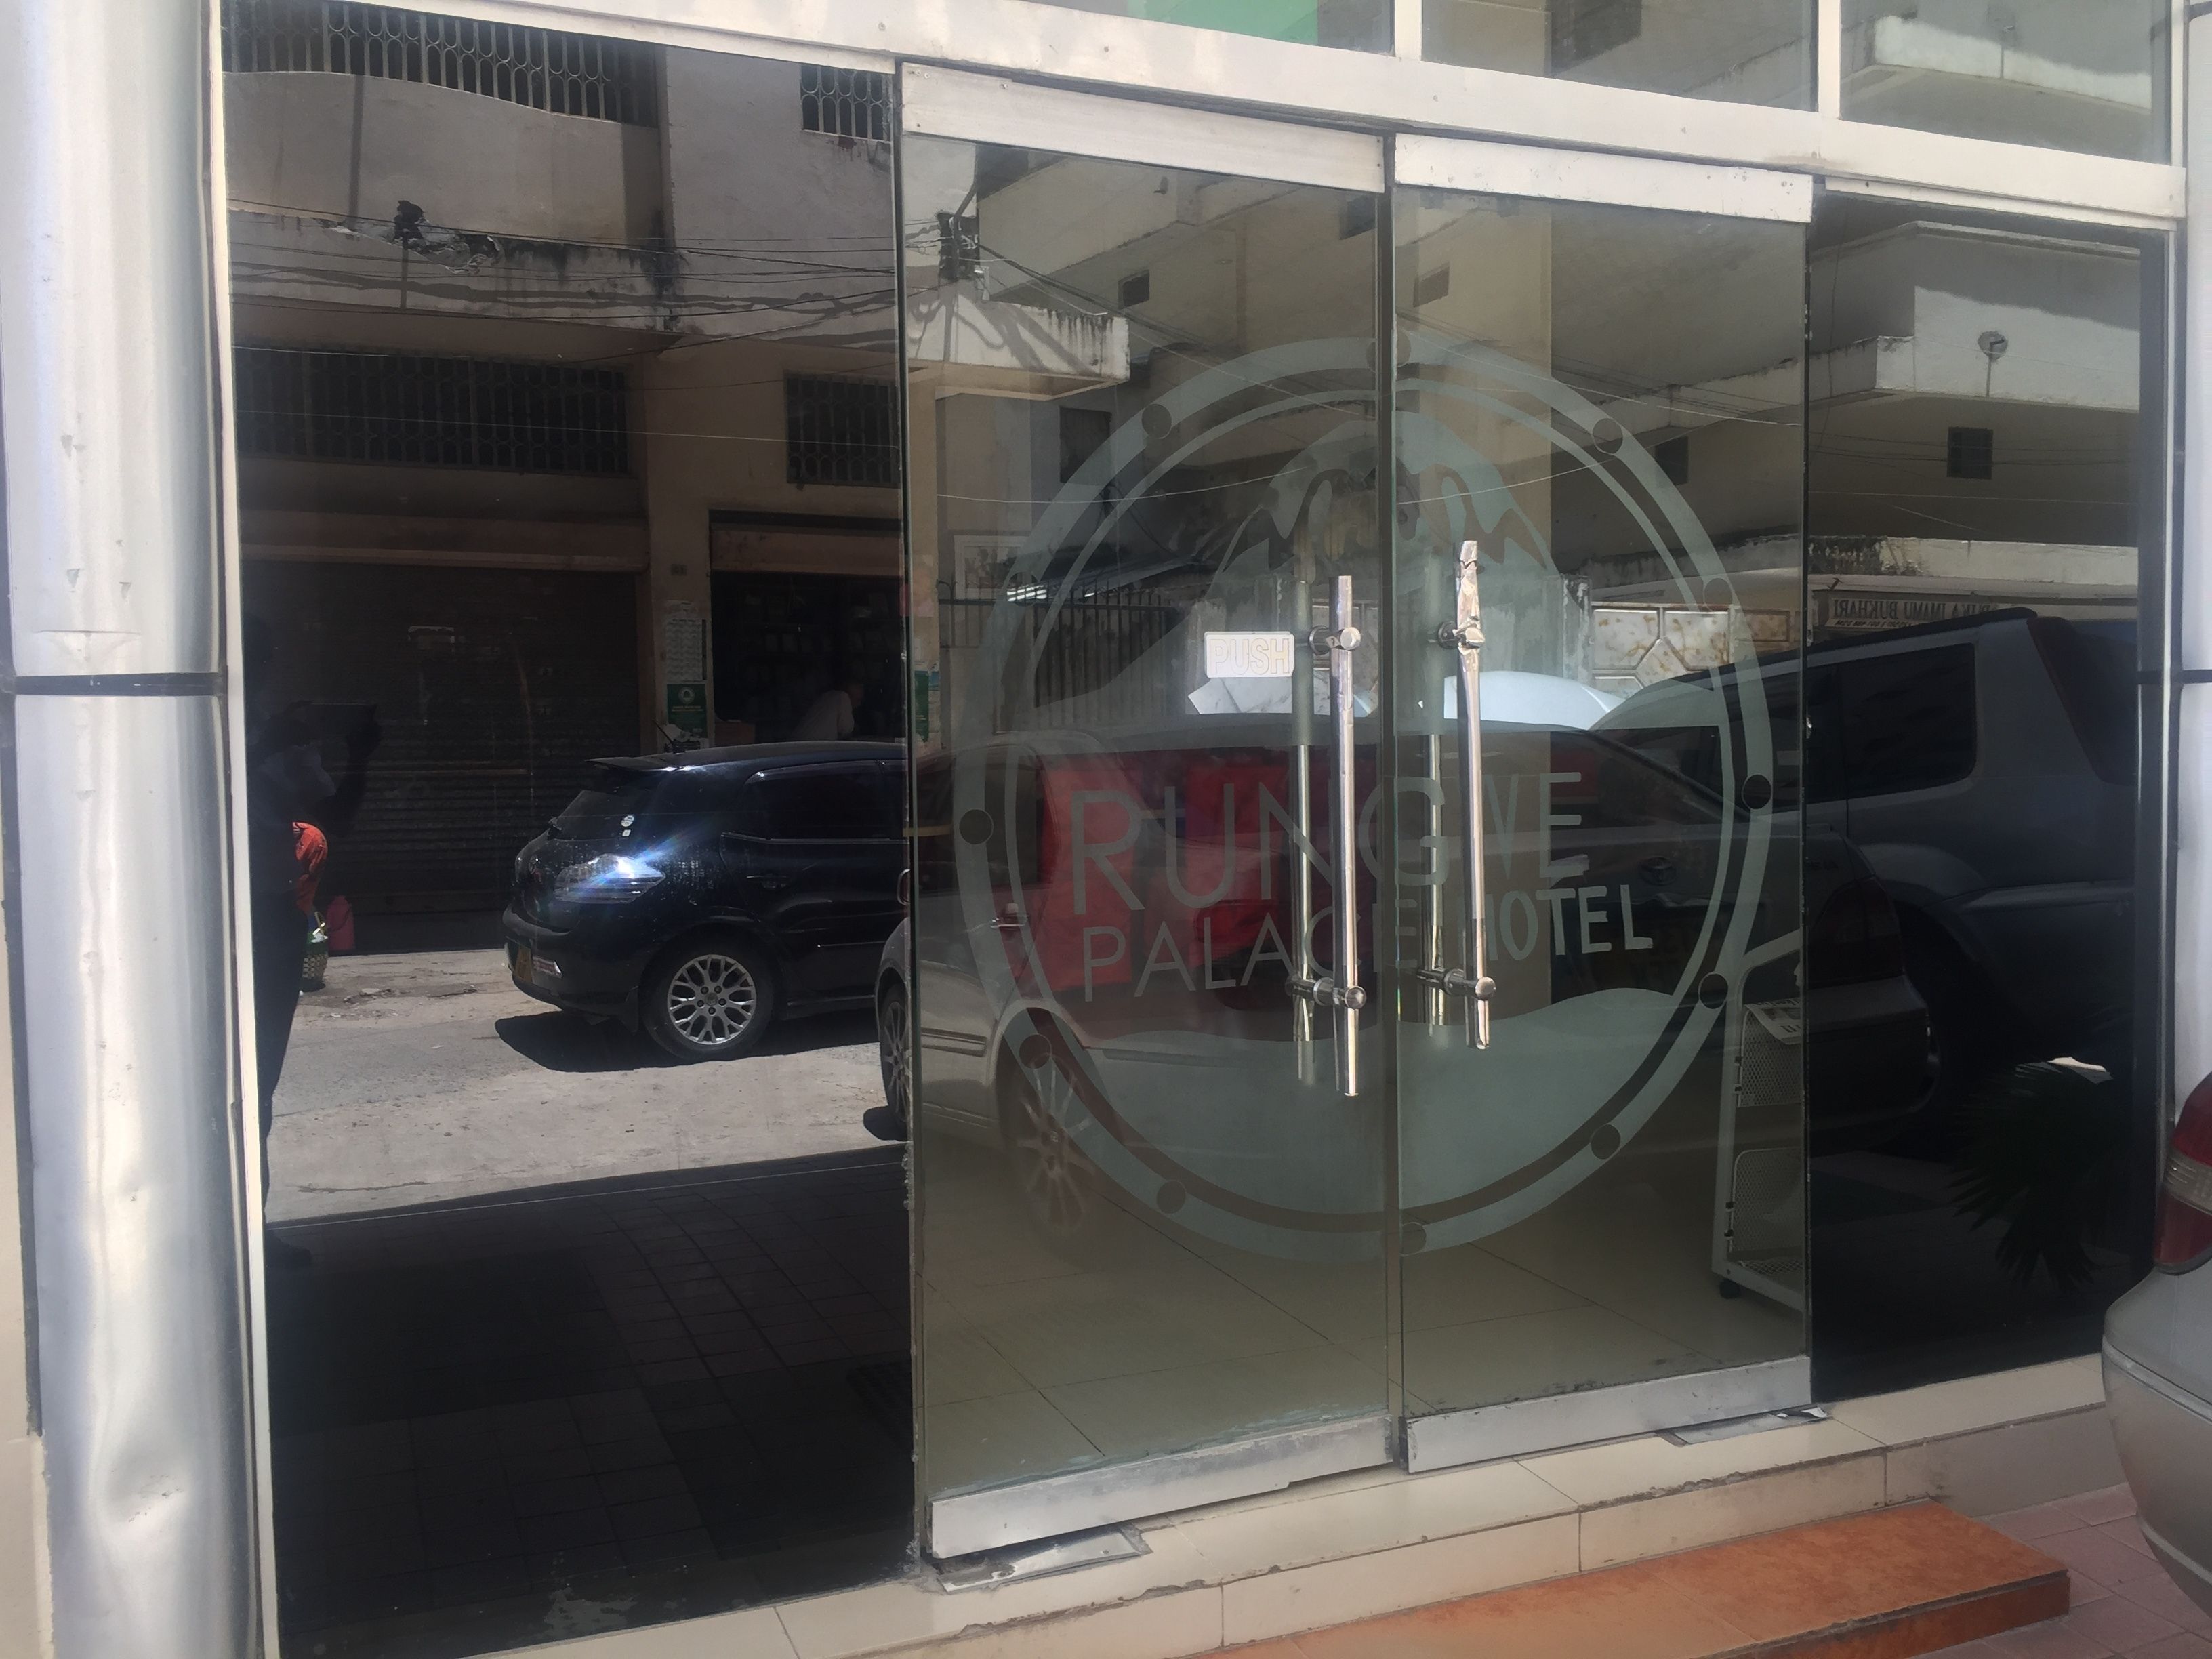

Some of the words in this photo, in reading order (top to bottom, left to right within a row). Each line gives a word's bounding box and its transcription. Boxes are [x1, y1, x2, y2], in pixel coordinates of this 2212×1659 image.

[1209, 638, 1290, 675] PUSH
[1083, 899, 1418, 1002] PALACE
[1458, 884, 1654, 962] HOTEL
